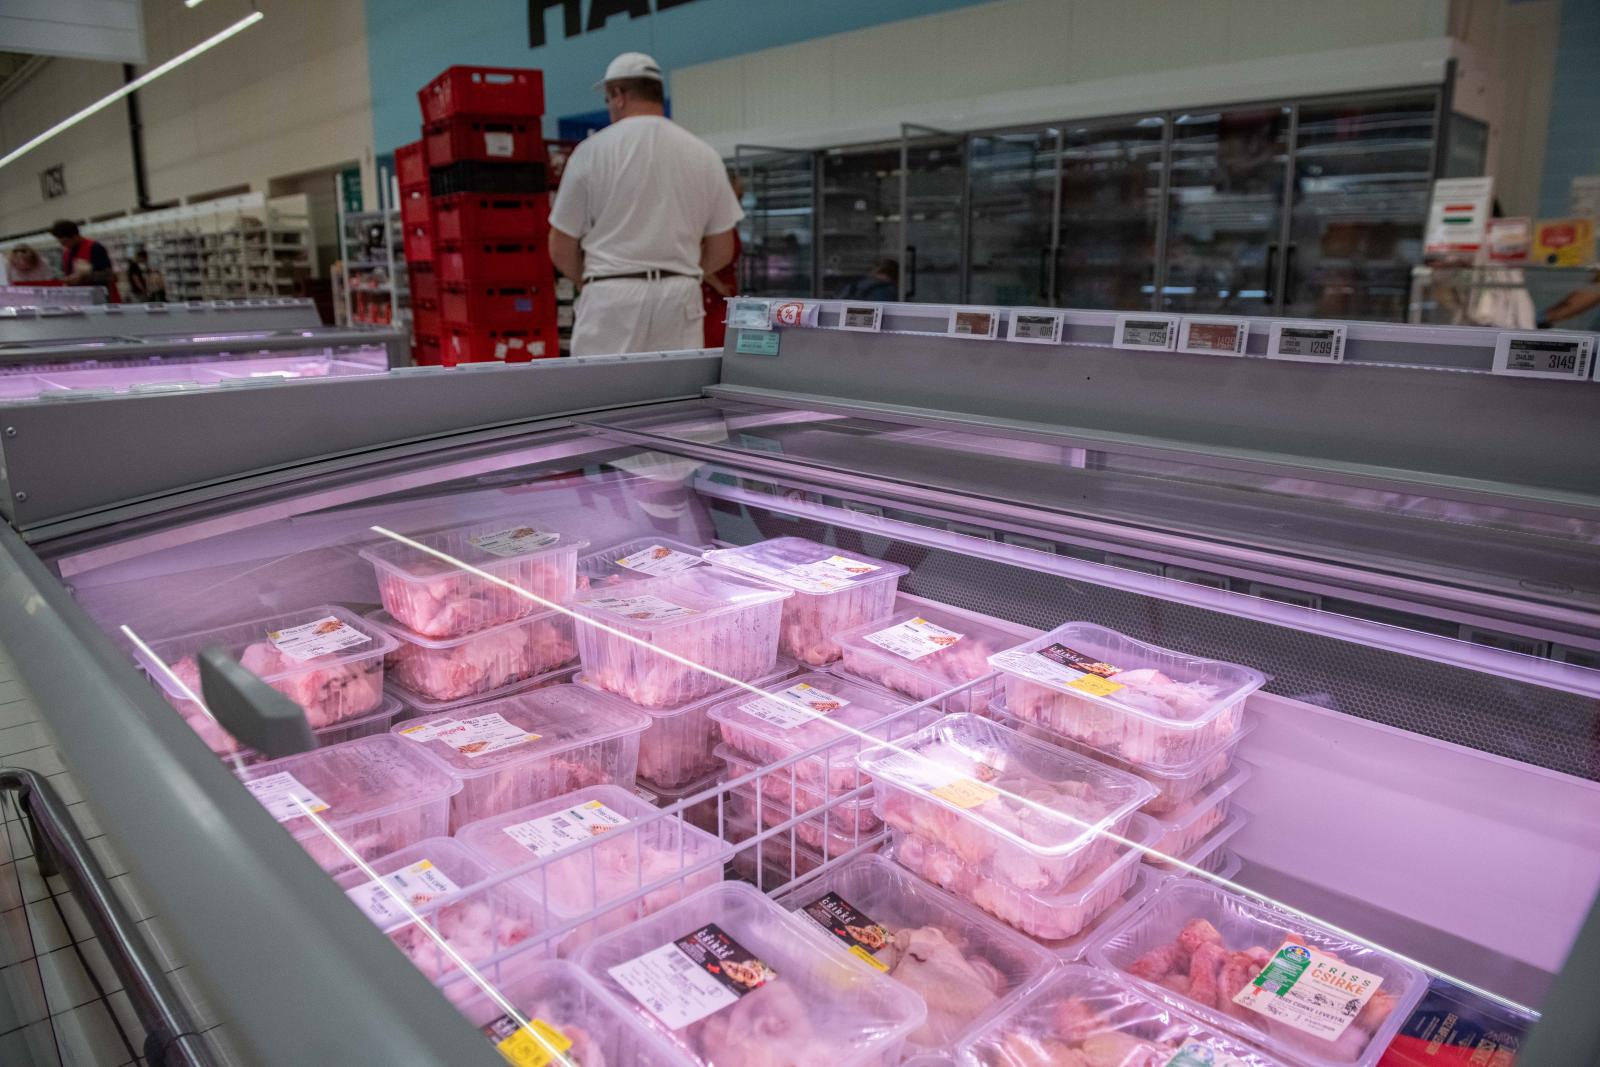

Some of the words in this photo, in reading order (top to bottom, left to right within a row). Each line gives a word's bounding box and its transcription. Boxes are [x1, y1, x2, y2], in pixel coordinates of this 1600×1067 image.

[1310, 340, 1332, 354] 1299
[1549, 354, 1576, 370] 3149
[822, 898, 852, 923] CSIRKE
[1311, 968, 1366, 996] CSIRKE
[1317, 961, 1372, 987] FRISS
